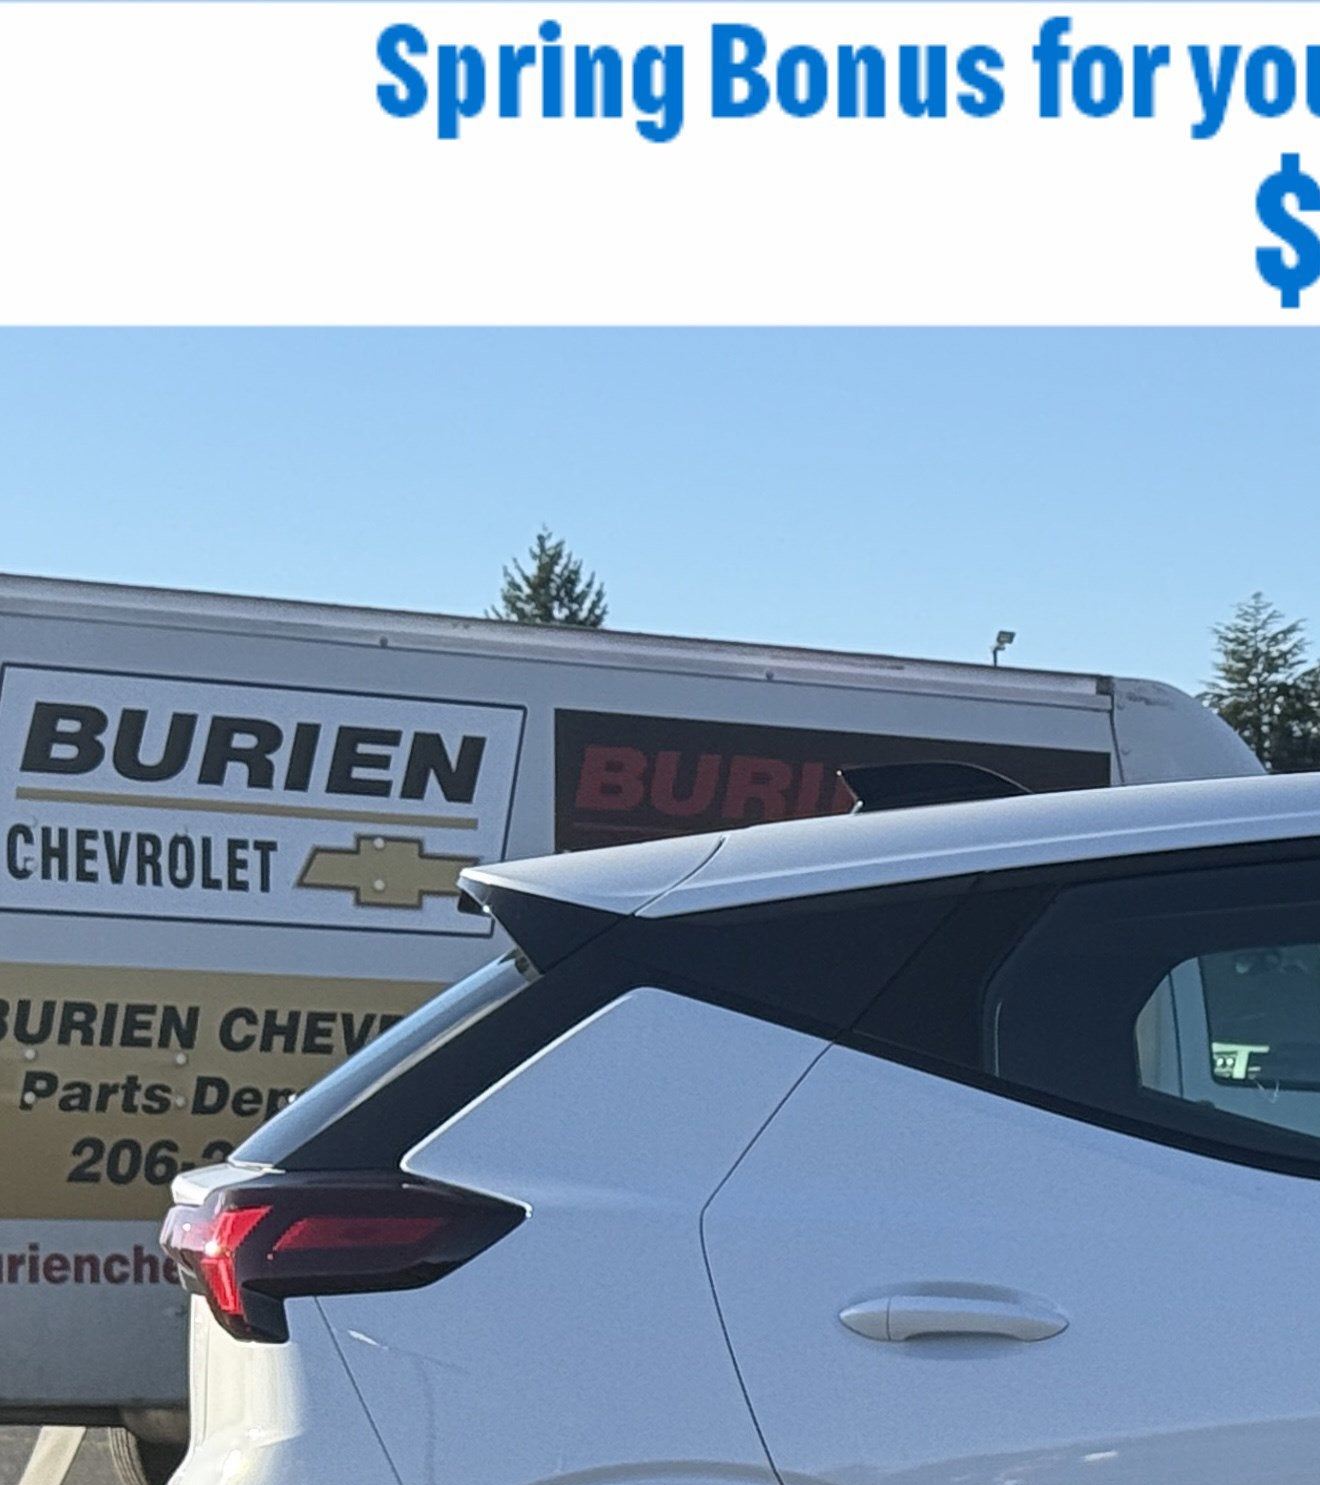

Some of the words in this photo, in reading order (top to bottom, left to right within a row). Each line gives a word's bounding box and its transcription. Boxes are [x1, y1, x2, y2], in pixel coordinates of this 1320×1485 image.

[19, 700, 488, 805] BURIEN
[6, 821, 279, 893] CHEVROLET
[18, 1070, 172, 1116] Parts
[190, 1075, 306, 1121] Dep
[0, 1242, 180, 1285] rienche
